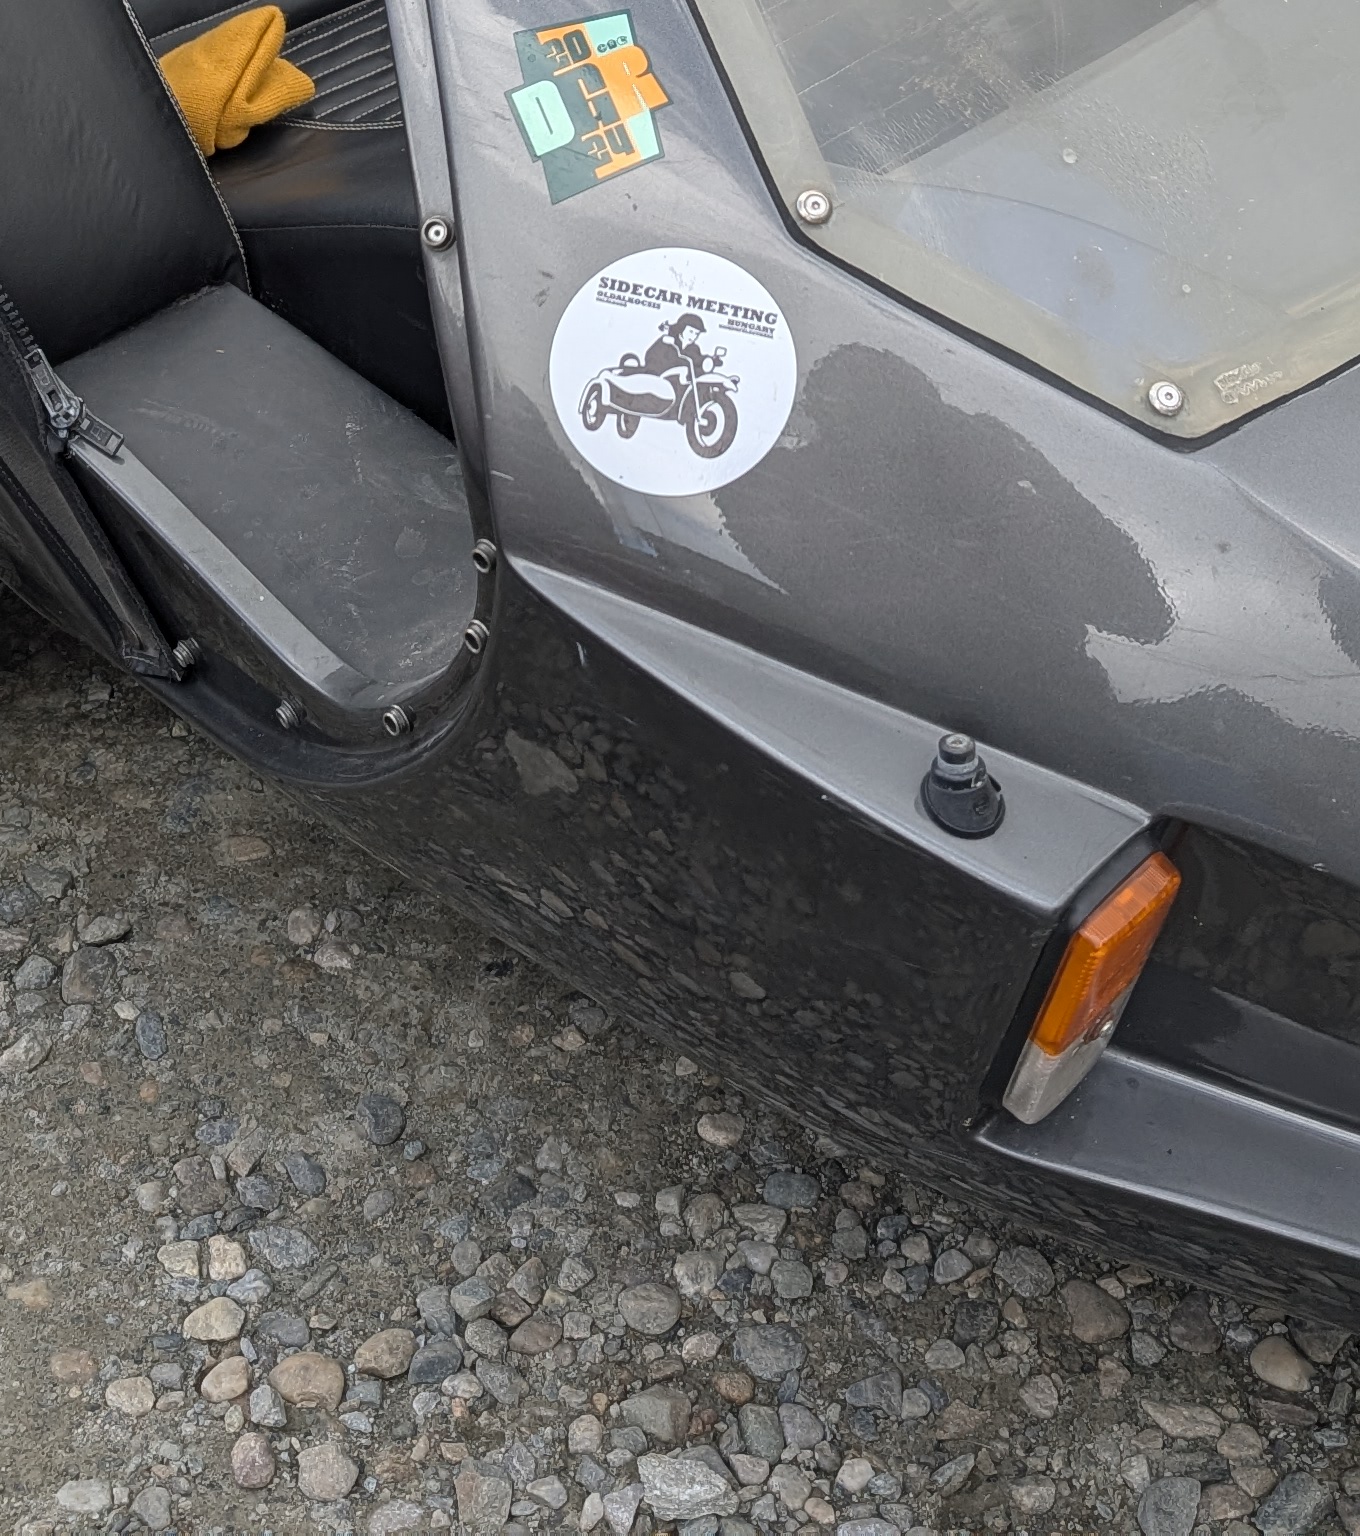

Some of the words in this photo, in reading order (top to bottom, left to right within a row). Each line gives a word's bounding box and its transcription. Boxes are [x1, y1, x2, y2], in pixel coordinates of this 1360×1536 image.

[597, 275, 683, 307] SIDECAR
[685, 295, 779, 325] MEETING
[727, 318, 776, 335] HUNGARY
